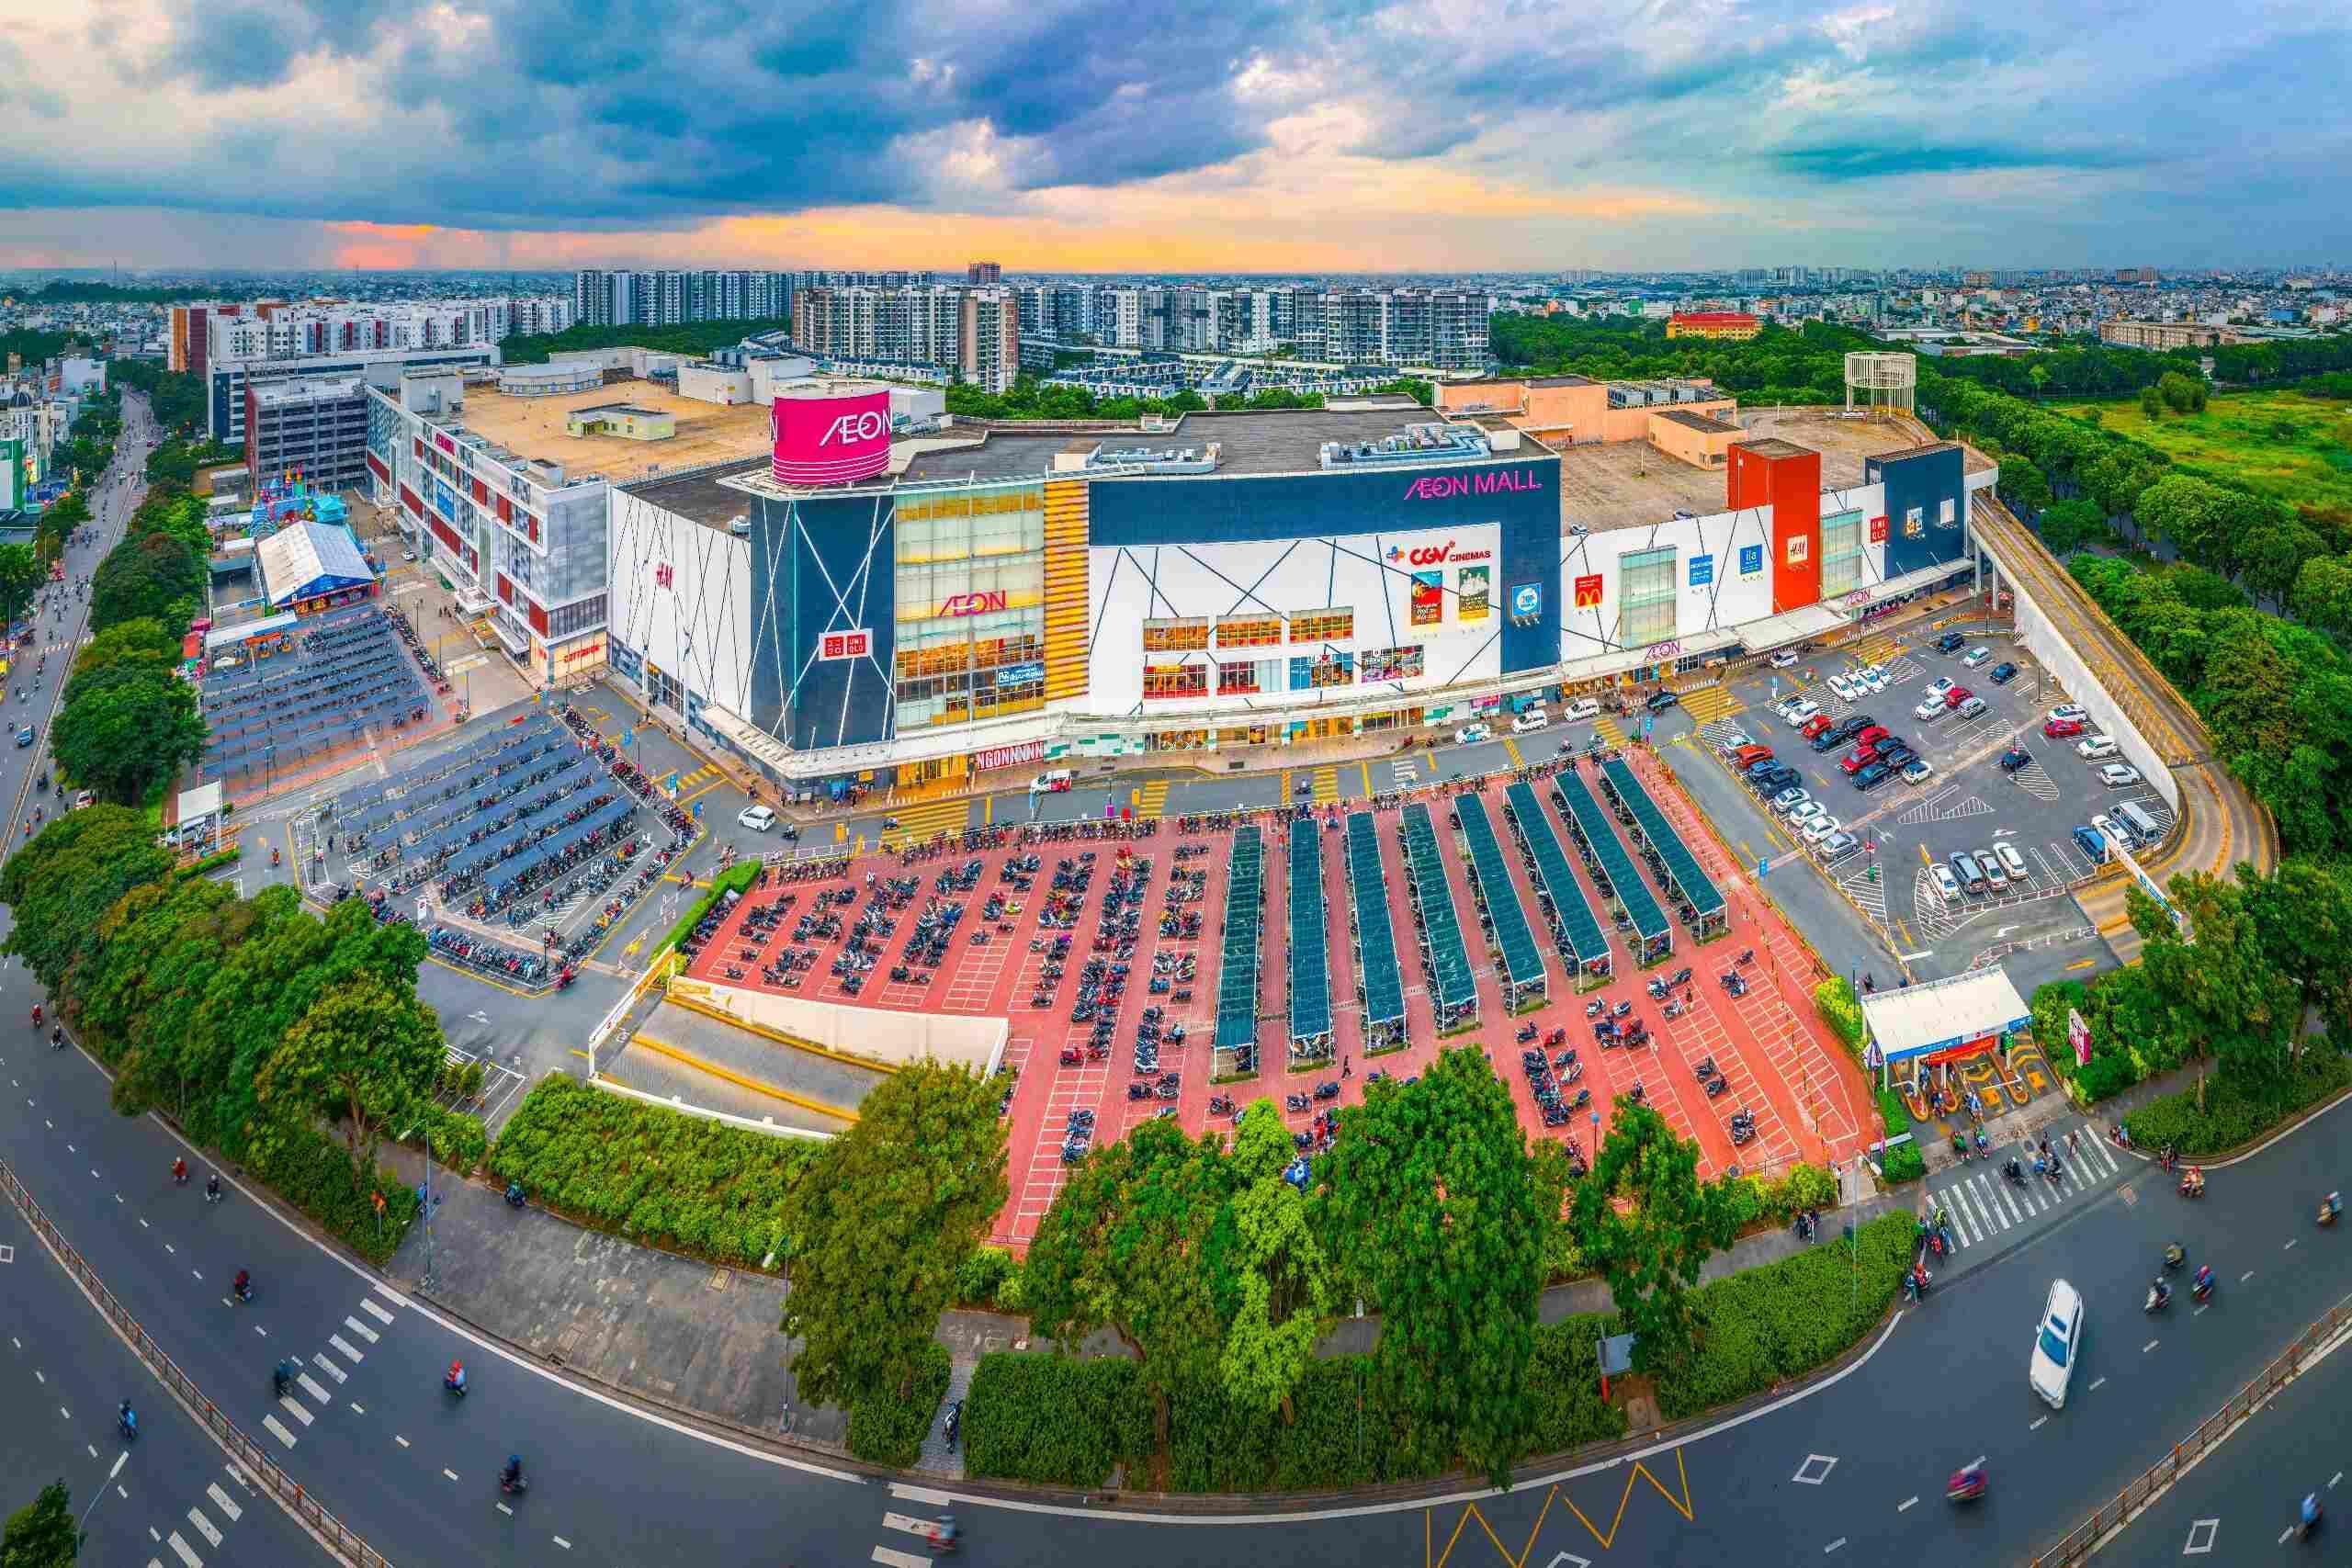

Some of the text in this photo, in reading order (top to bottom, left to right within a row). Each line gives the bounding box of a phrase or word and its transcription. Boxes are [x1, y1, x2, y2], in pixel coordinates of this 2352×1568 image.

[1474, 469, 1544, 494] MALL
[1409, 546, 1491, 566] CGV CINEMAS
